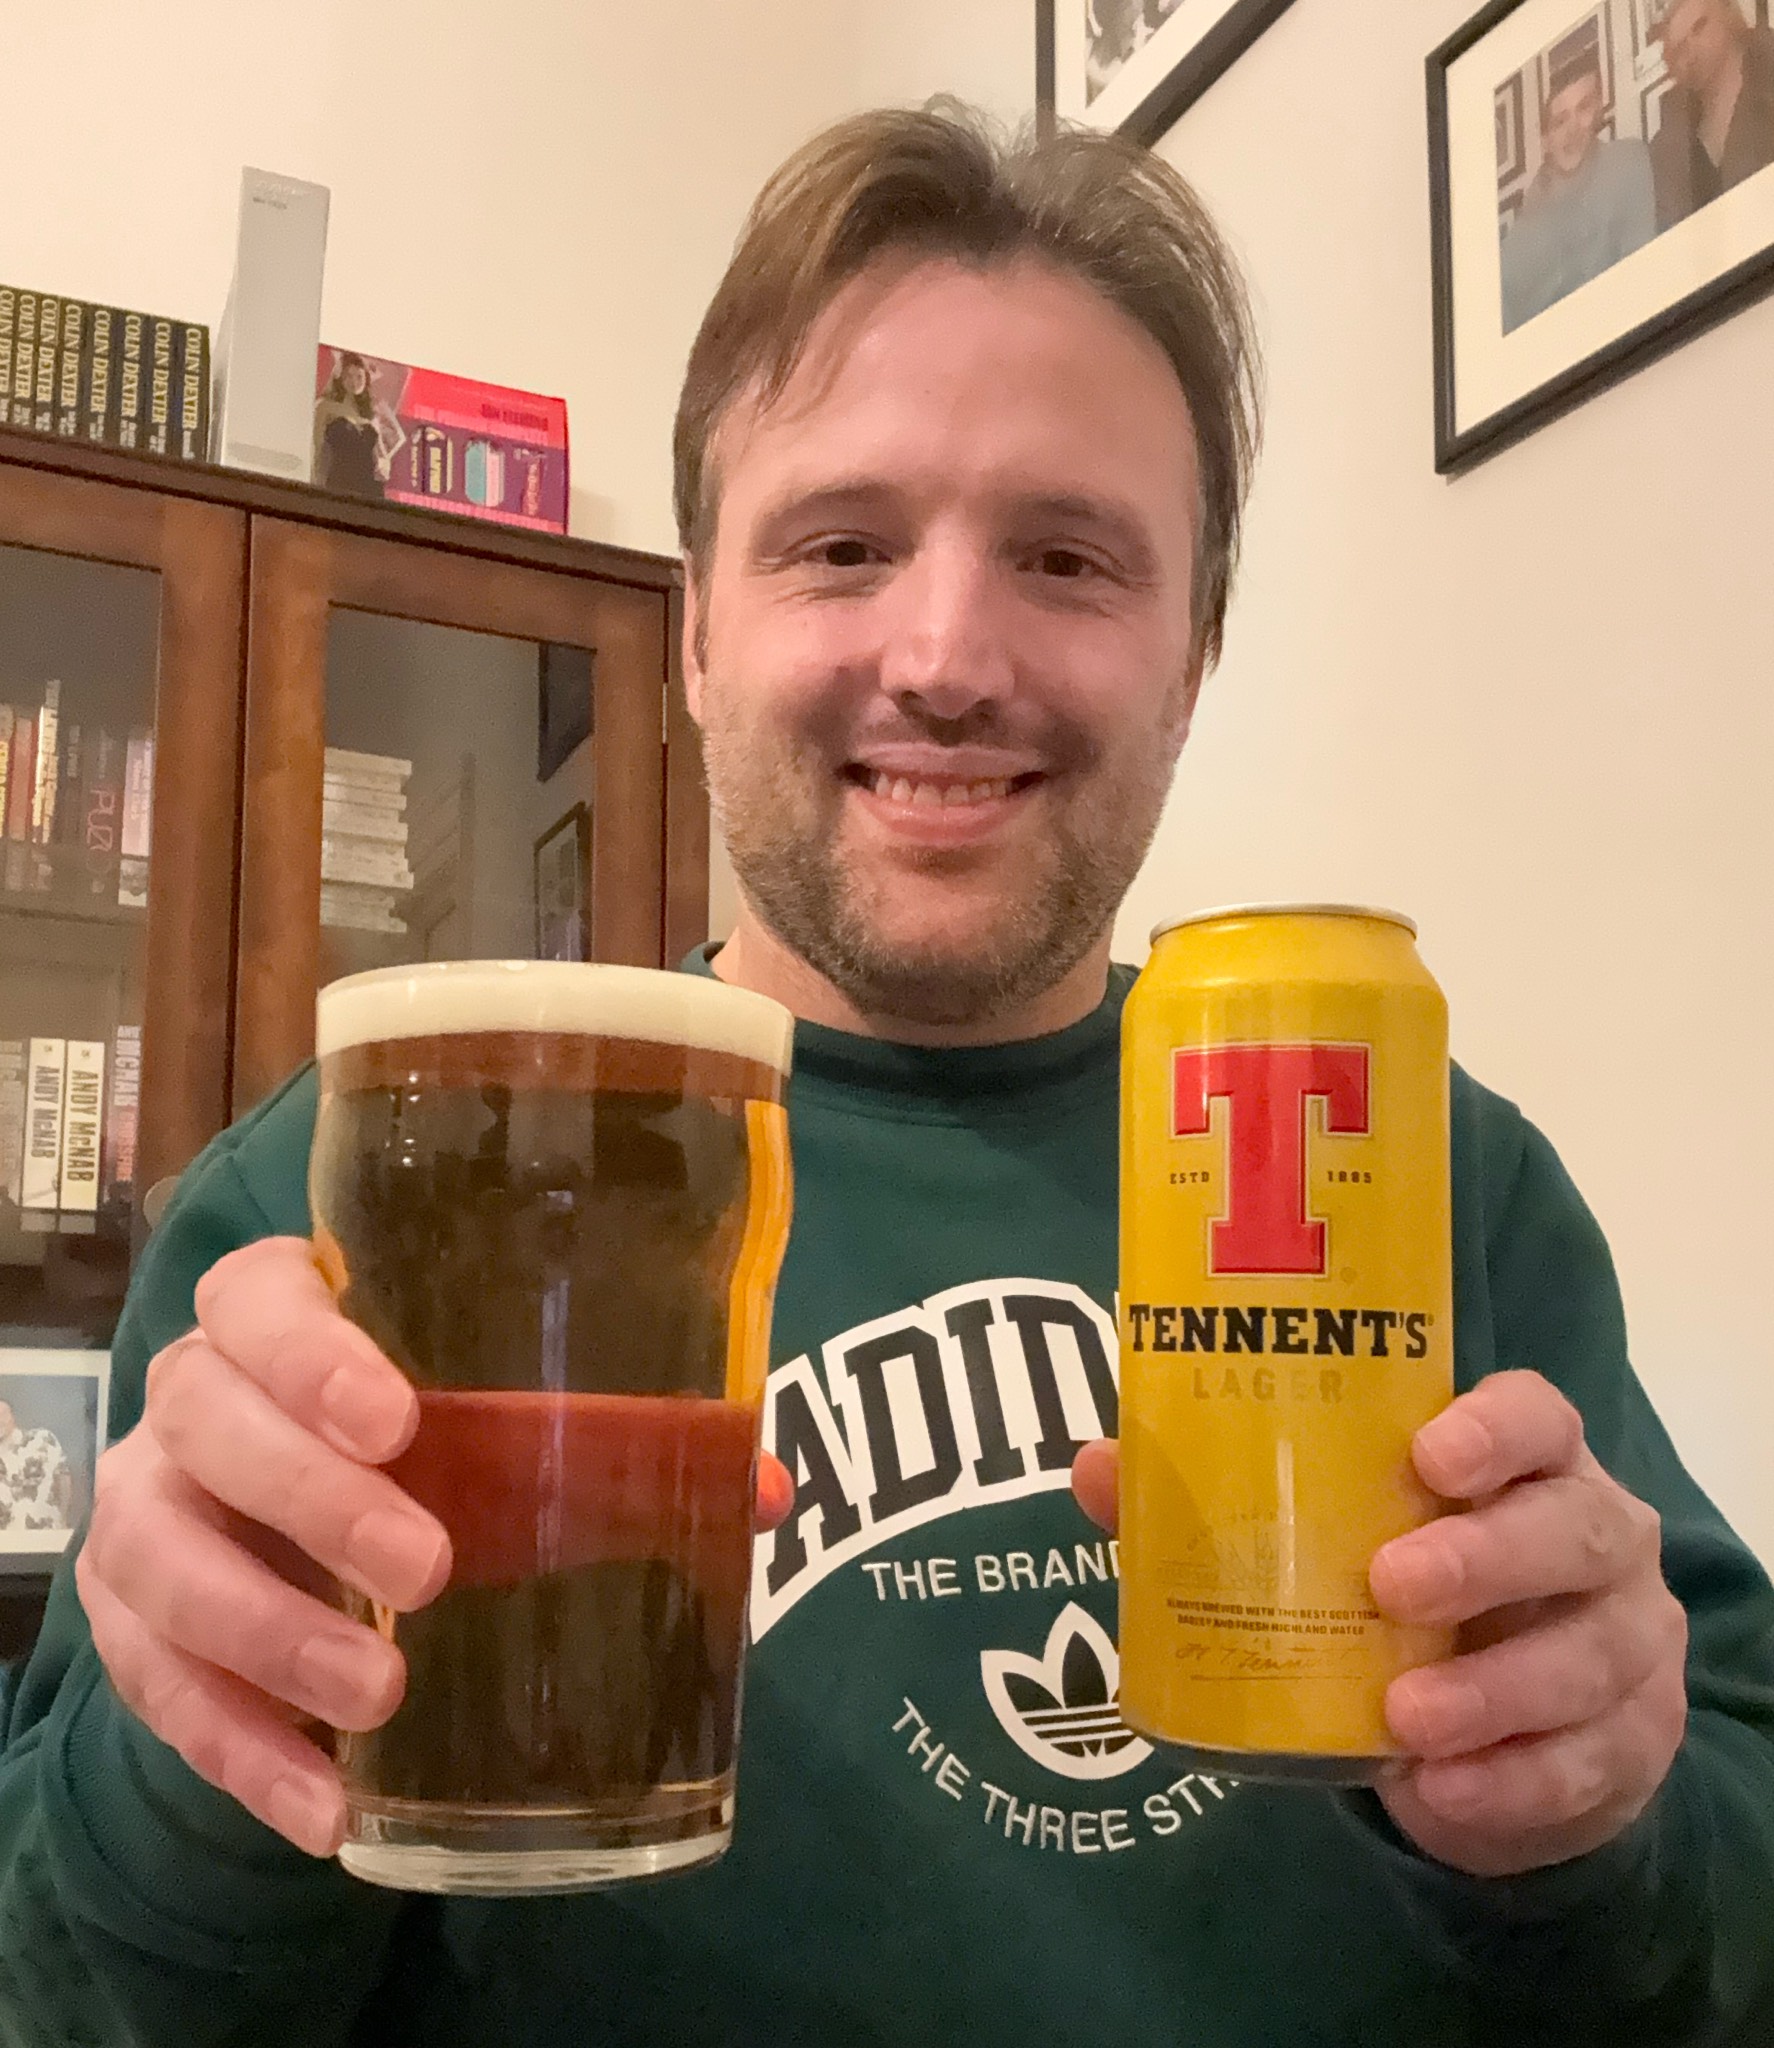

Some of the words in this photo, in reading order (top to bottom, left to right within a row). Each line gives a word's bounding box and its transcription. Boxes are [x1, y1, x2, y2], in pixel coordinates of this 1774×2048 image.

[0, 290, 15, 335] COLIN
[18, 295, 36, 340] COLIN
[40, 299, 57, 345] COLIN
[64, 304, 82, 350] COLIN
[93, 311, 111, 356] COLIN
[124, 315, 141, 361] COLIN
[154, 322, 171, 367] COLIN
[185, 328, 201, 373] COLIN
[14, 341, 34, 399] DEXTER
[36, 345, 55, 402] DEXTER
[60, 350, 79, 407] DEXTER
[90, 356, 109, 413] DEXTER
[121, 361, 140, 417] DEXTER
[151, 368, 170, 424] DEXTER
[182, 374, 199, 430] DEXTER
[34, 1065, 60, 1104] ANDY
[70, 1070, 99, 1116] ANDY
[31, 1108, 58, 1159] McNAB
[66, 1121, 96, 1182] McNAB
[1169, 1040, 1372, 1279] T
[1169, 1170, 1210, 1184] ESTD
[1327, 1170, 1372, 1184] 1885
[1129, 1303, 1428, 1359] TENNENT'S
[1192, 1367, 1343, 1403] LAGER
[750, 1277, 1120, 1645] ADID
[861, 1558, 961, 1601] THE
[1166, 1598, 1200, 1611] ALWAYS
[1202, 1602, 1243, 1615] BREWED
[1245, 1606, 1275, 1617] WITH
[1278, 1608, 1297, 1618] THE
[1300, 1608, 1327, 1619] BEST
[1329, 1609, 1380, 1621] SCOTTISH
[1177, 1615, 1212, 1627] BARLEY
[1213, 1618, 1234, 1628] AND
[1236, 1620, 1269, 1631] FRESH
[1271, 1622, 1327, 1634] HIGHLAND
[1329, 1625, 1364, 1635] WATER
[892, 1697, 971, 1801] THE
[981, 1781, 1136, 1854] THREE
[1143, 1774, 1240, 1836] ST
